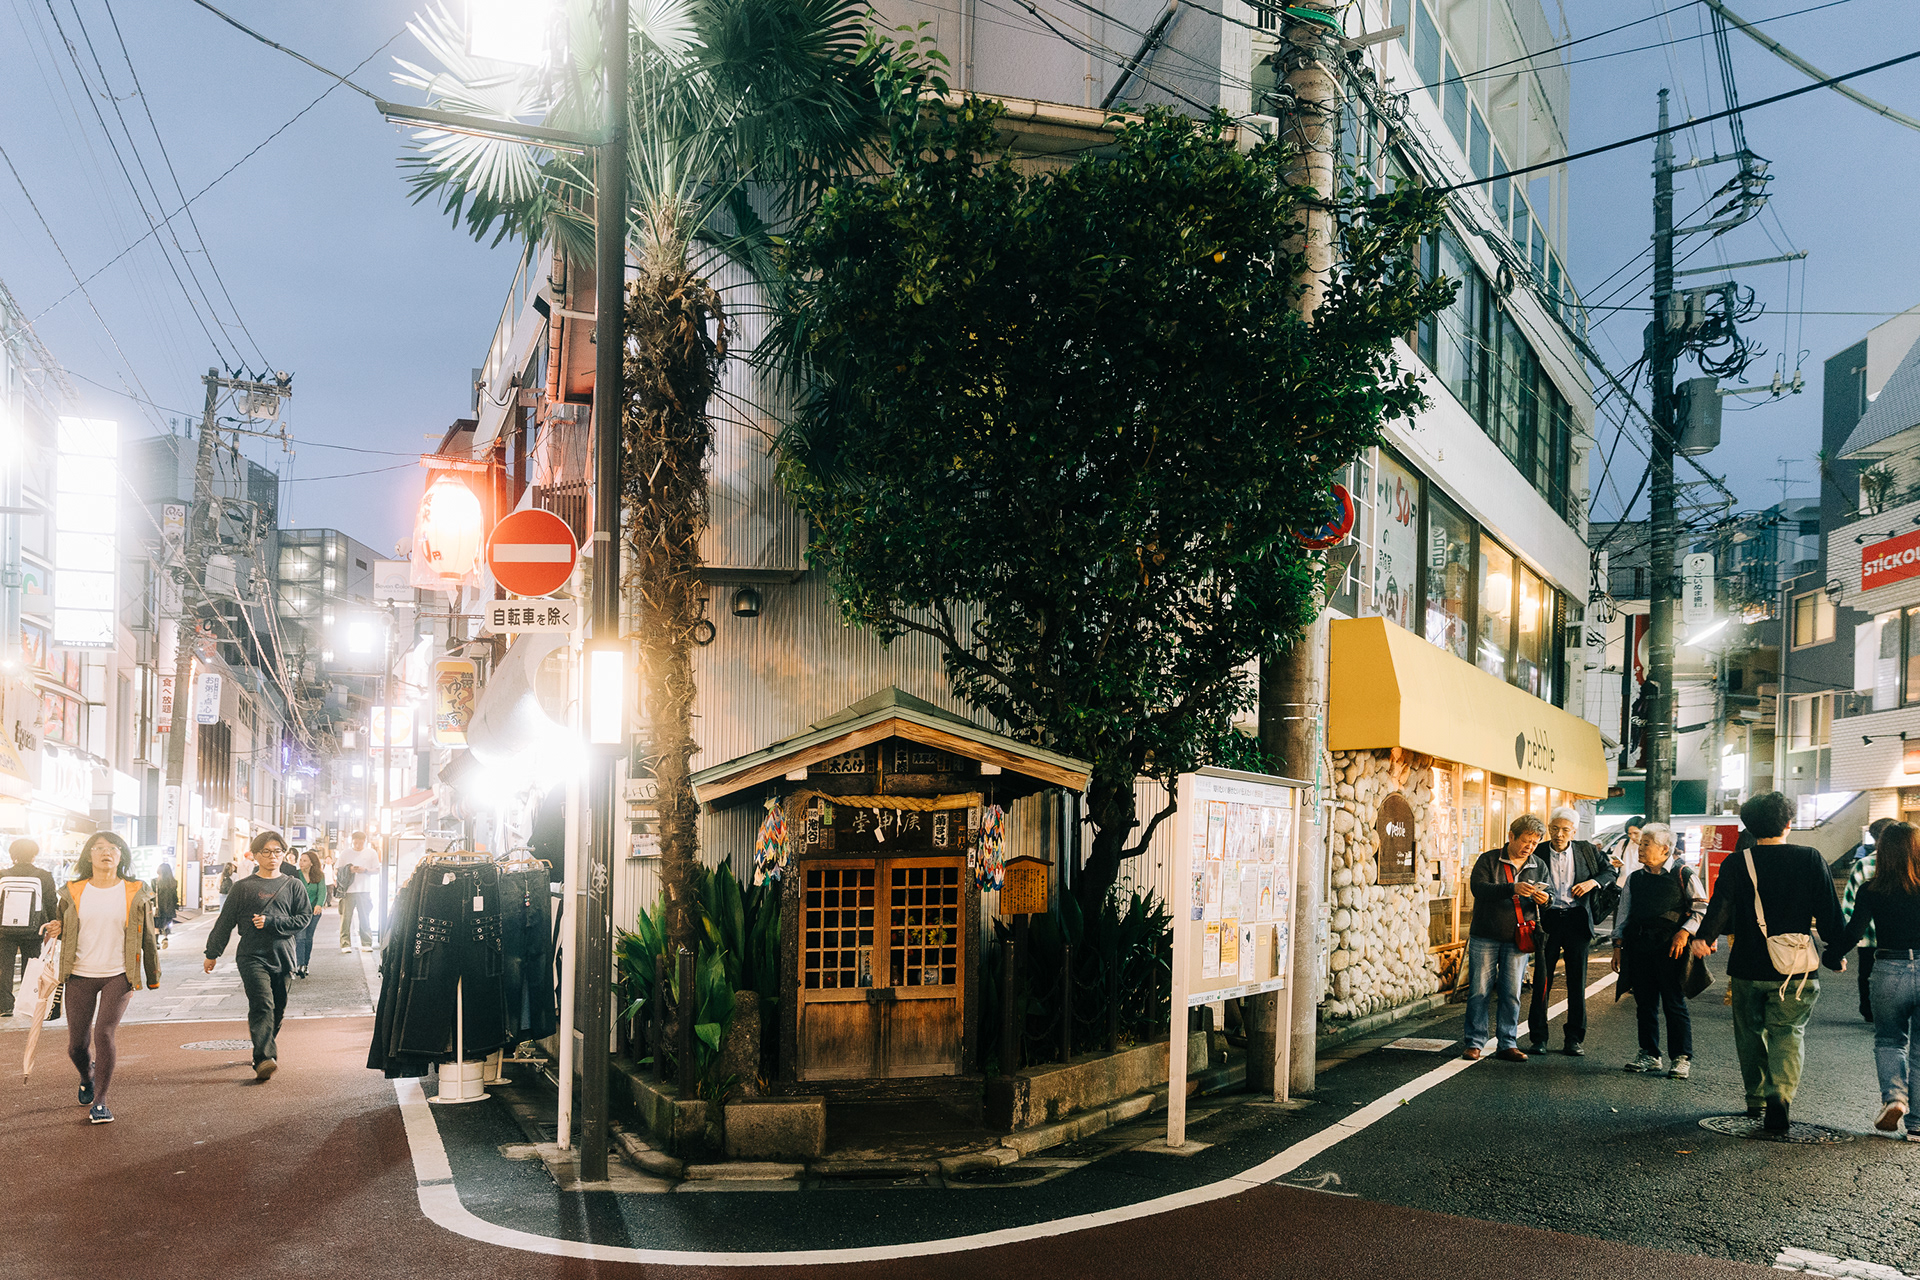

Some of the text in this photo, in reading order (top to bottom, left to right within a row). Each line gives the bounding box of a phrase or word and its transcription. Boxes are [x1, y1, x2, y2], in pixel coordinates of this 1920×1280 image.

[493, 607, 570, 626] 自転車を除く
[1527, 726, 1556, 777] pebble
[1392, 821, 1406, 838] pebble
[132, 849, 154, 861] 2F
